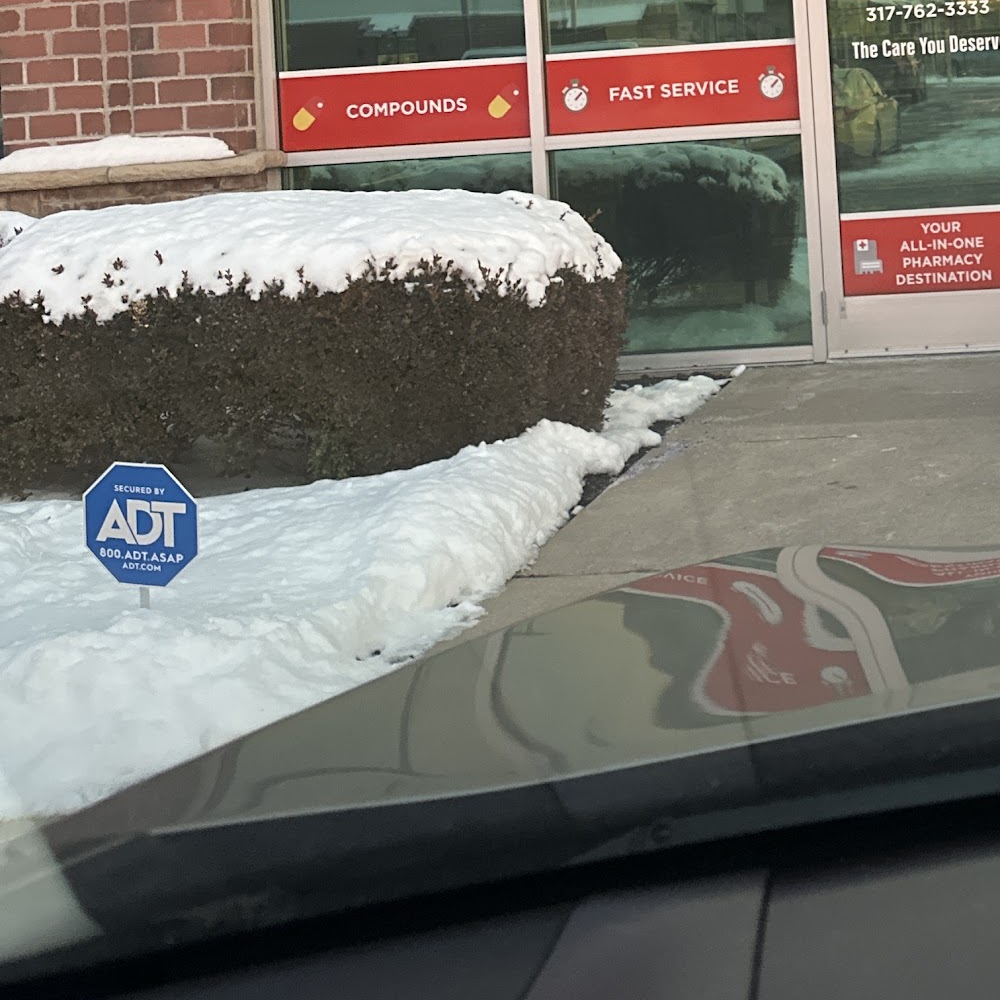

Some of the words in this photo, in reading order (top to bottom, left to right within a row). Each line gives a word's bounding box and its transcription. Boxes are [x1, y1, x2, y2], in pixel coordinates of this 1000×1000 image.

[866, 0, 990, 22] 317-762-3333
[852, 41, 878, 59] The
[882, 39, 916, 57] Care
[919, 36, 945, 54] You
[609, 85, 655, 102] FAST
[660, 79, 739, 98] SERVICE
[346, 97, 468, 119] COMPOUNDS
[920, 221, 961, 234] YOUR
[900, 236, 984, 252] ALL-IN-ONE
[903, 253, 983, 268] PHARMACY
[896, 269, 992, 286] DESTINATION
[114, 485, 152, 495] SECURED
[96, 498, 187, 548] ADT
[99, 547, 184, 564] 800.ADT.ASAP
[122, 562, 161, 572] ADT.COM
